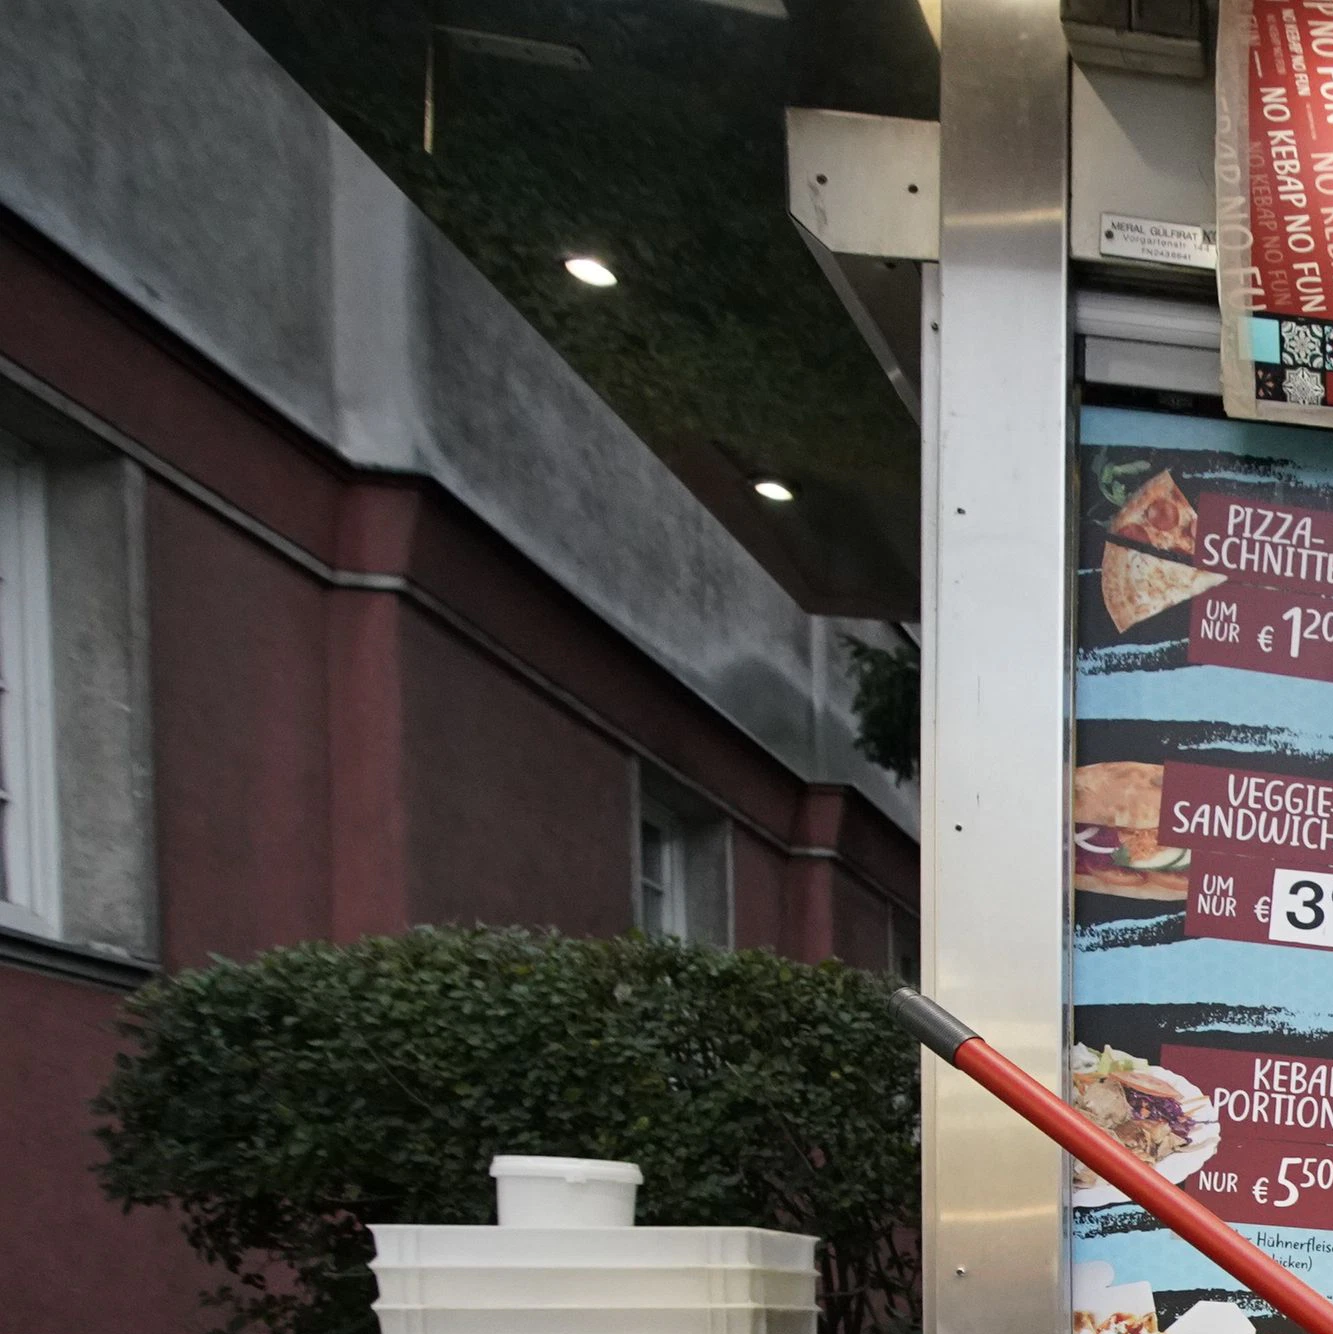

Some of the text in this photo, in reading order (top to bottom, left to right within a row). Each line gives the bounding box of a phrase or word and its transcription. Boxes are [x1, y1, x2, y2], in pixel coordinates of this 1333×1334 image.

[1227, 504, 1325, 549] PIZZA-
[1206, 599, 1238, 622] UM
[1201, 618, 1240, 643] NUR
[1203, 873, 1234, 896] UM
[1197, 895, 1236, 917] NUR
[1199, 1170, 1239, 1193] NUR
